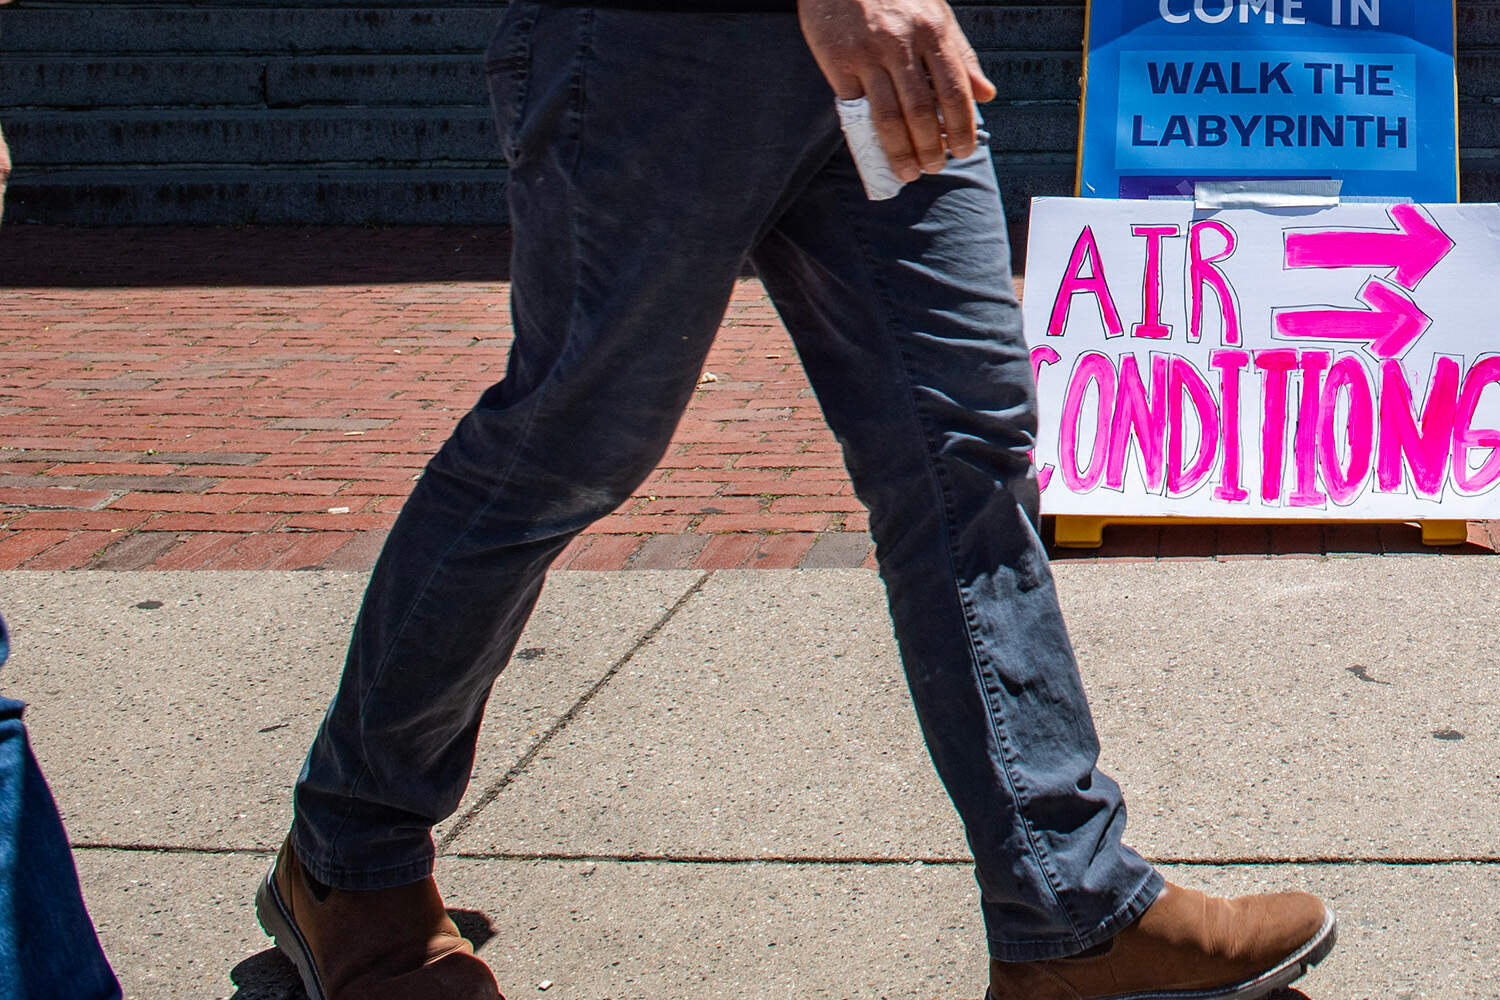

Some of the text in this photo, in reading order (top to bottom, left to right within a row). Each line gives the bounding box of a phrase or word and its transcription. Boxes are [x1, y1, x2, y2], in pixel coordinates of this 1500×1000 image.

[1147, 61, 1394, 96] WALK THE
[1131, 114, 1407, 148] LABYRINTH
[1046, 219, 1243, 348] AIR
